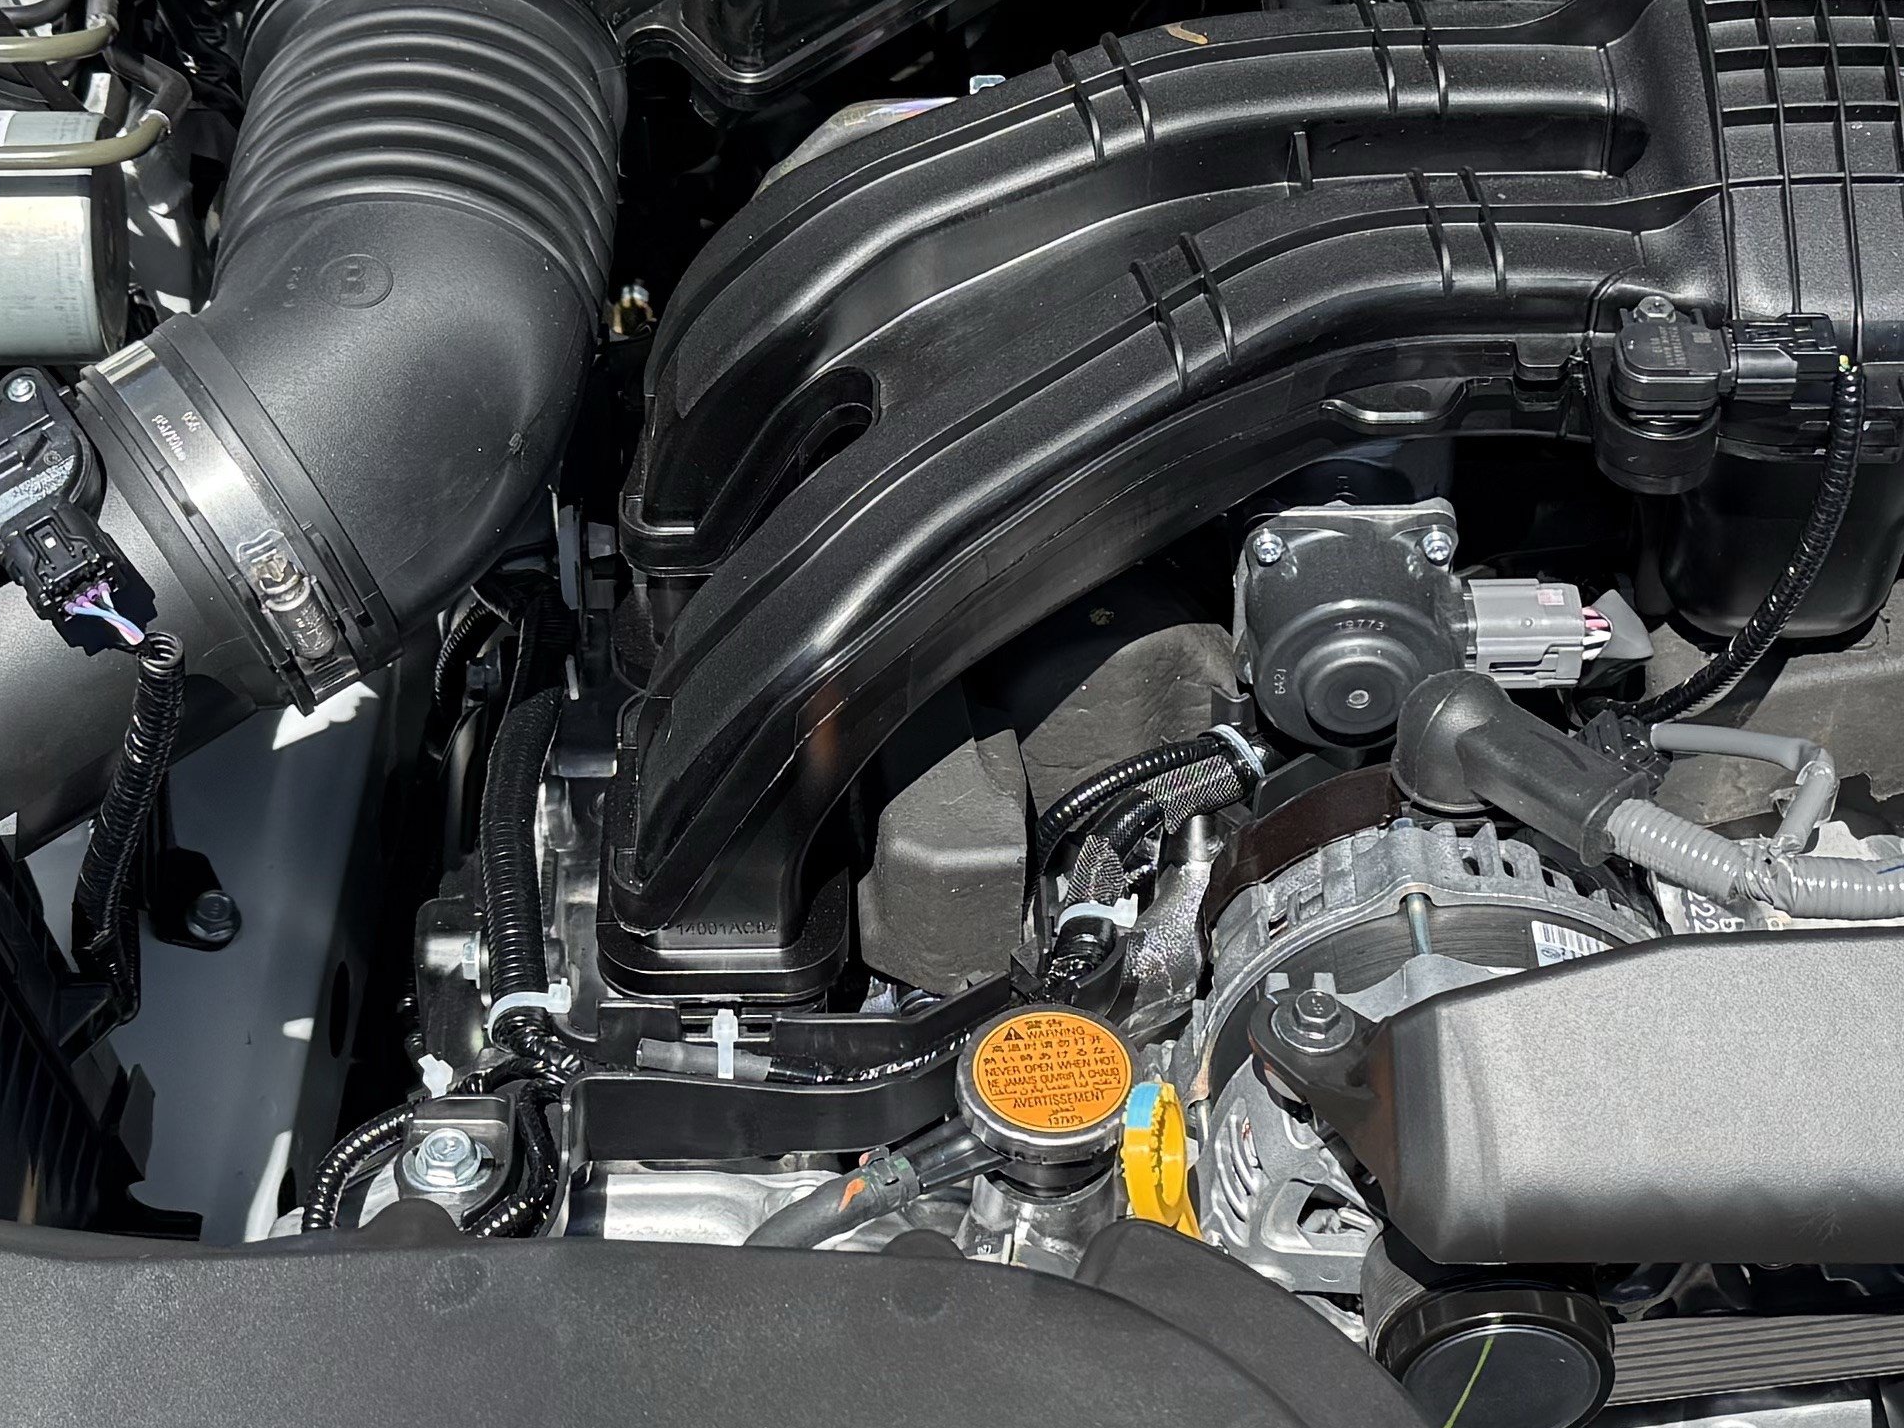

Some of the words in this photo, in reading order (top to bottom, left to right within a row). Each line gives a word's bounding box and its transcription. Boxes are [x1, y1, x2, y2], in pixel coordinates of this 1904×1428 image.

[1026, 1026, 1085, 1040] WARNING
[985, 1065, 1021, 1076] NEVER
[1025, 1062, 1053, 1073] OPEN
[1059, 1058, 1091, 1070] WHEN
[1003, 1075, 1037, 1087] JAMAIS
[1040, 1072, 1074, 1084] OUVRIR
[1088, 1068, 1119, 1079] CHAUD
[1013, 1090, 1106, 1109] AVERTISSEMENT
